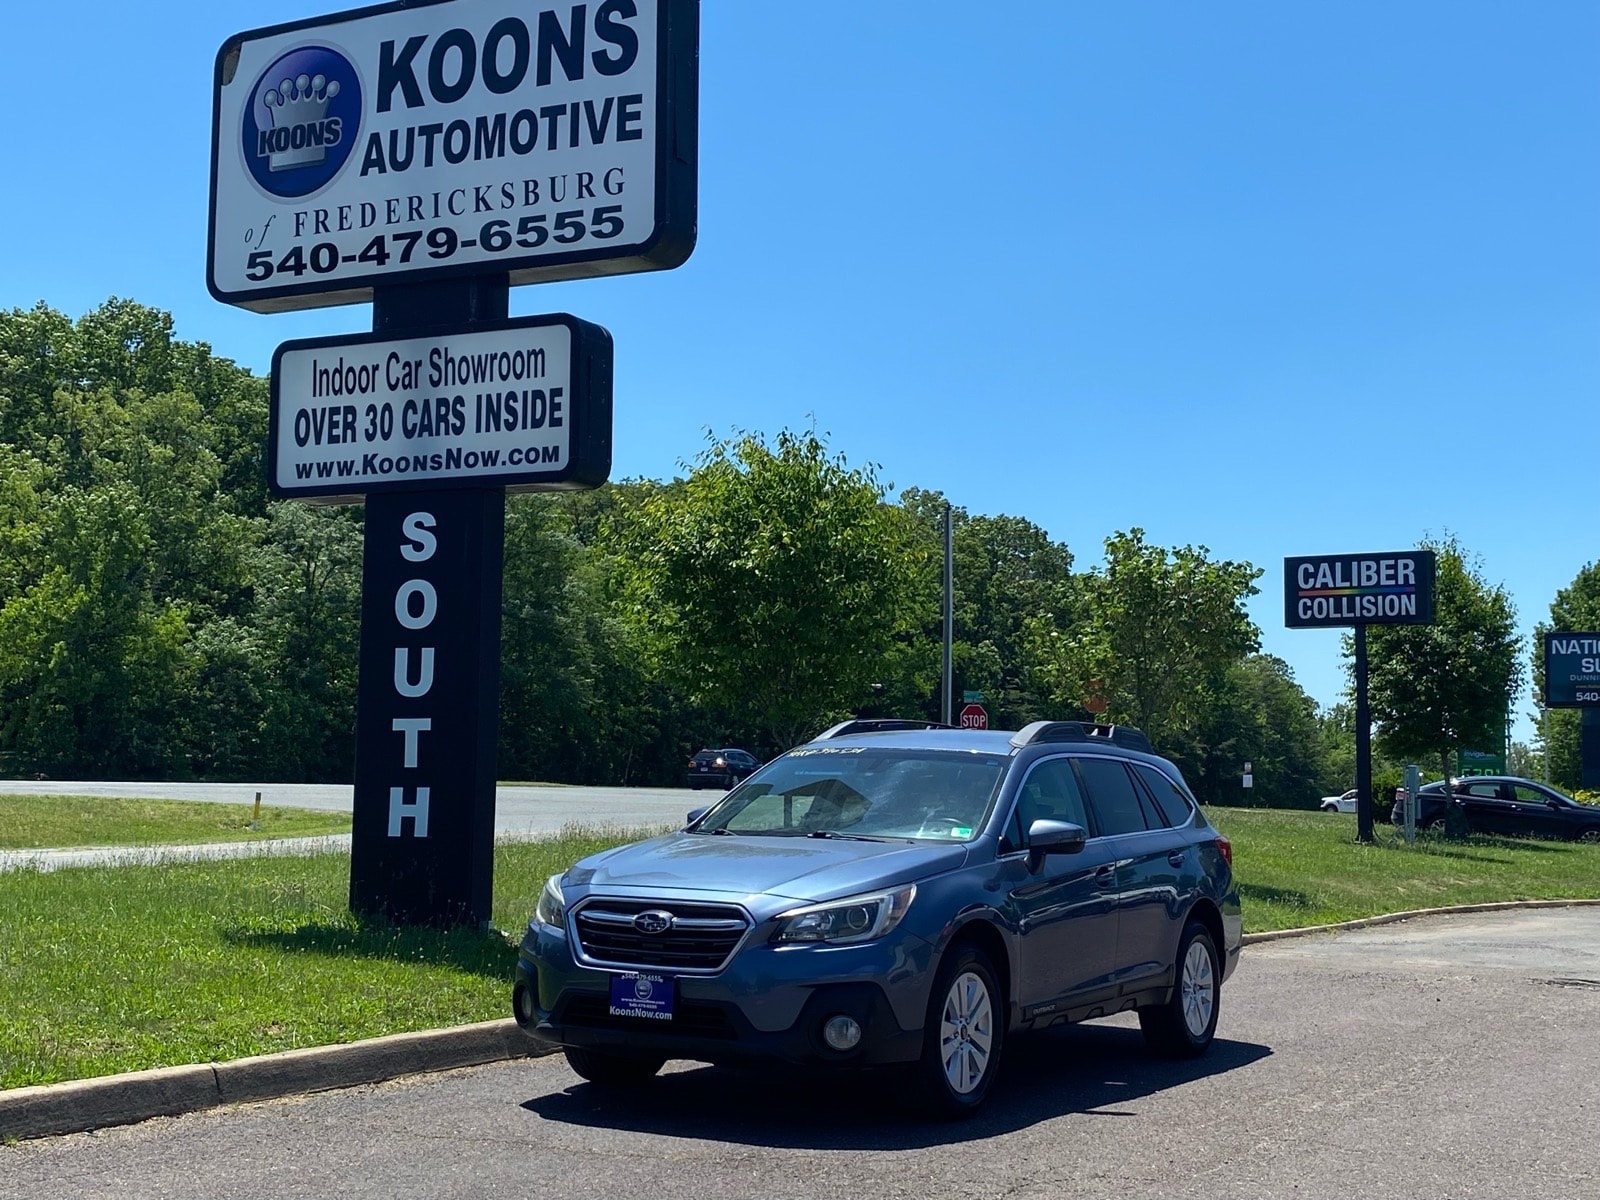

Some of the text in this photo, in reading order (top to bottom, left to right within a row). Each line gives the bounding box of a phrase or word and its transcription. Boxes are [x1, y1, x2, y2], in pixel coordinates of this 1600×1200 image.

[376, 0, 639, 113] KOONS
[259, 118, 342, 155] KOONS
[360, 94, 643, 177] AUTOMOTIVE
[244, 167, 625, 250] of FREDERICKSBURG
[245, 205, 625, 282] 540-479-6555
[312, 347, 545, 398] Indoor Car Showroom
[294, 387, 563, 448] OVER 30 CARS INSIDE
[1297, 558, 1416, 590] CALIBER
[1298, 594, 1416, 620] COLLISION
[1551, 639, 1600, 655] NATI
[387, 511, 438, 837] SOUTH
[962, 715, 986, 727] STOP
[609, 1005, 672, 1021] KoonsNow.com
